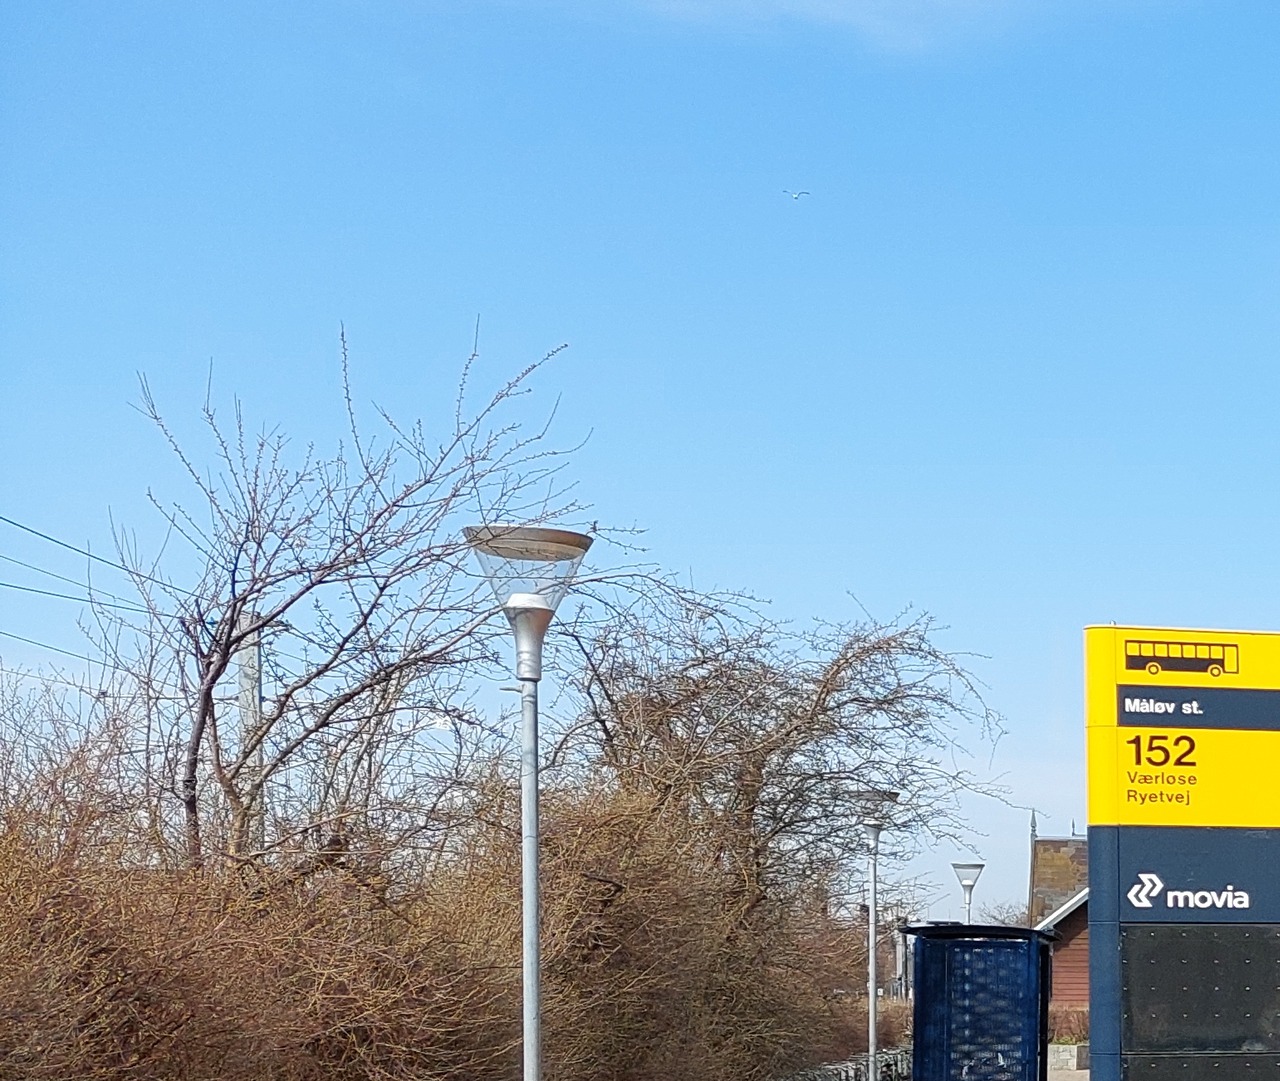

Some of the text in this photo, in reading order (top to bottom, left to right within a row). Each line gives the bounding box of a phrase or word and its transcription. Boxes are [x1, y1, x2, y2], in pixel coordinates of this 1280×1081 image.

[1124, 697, 1204, 715] Måløv st.
[1126, 734, 1197, 767] 152
[1126, 789, 1190, 806] Ryetvej
[1166, 885, 1250, 909] movia
